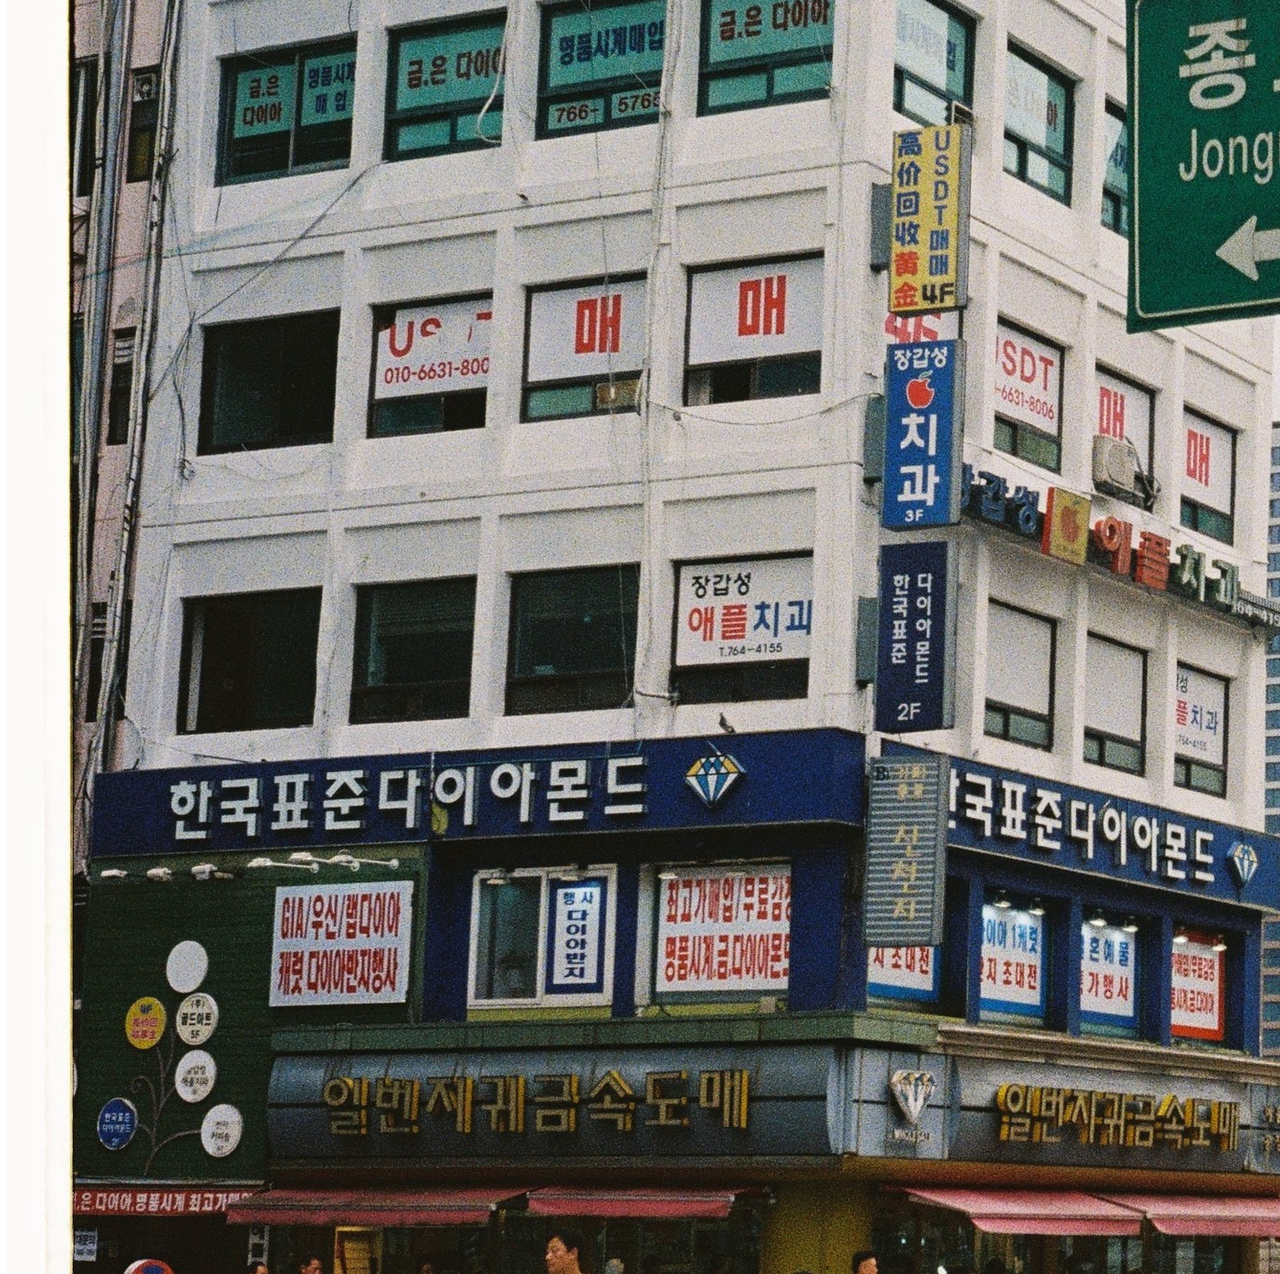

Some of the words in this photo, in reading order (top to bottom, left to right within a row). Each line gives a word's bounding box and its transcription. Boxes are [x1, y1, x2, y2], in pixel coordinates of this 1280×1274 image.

[243, 101, 284, 127] 다이아
[892, 131, 923, 309] 高价回收黄金
[738, 274, 787, 337] 매
[921, 282, 955, 306] 4F
[574, 294, 622, 355] 매
[894, 347, 948, 371] 장갑성
[1099, 385, 1126, 442] 매
[897, 411, 940, 508] 치과
[1186, 428, 1212, 487] 매
[904, 509, 924, 523] 3F
[691, 572, 752, 599] 장갑성
[891, 574, 911, 665] 한국표준
[914, 573, 933, 684] 다이아몬드
[897, 702, 921, 722] 2F
[170, 755, 649, 840] 한국표준다이아몬드
[563, 909, 589, 979] 다이아반지
[1080, 970, 1129, 1002] 가행사
